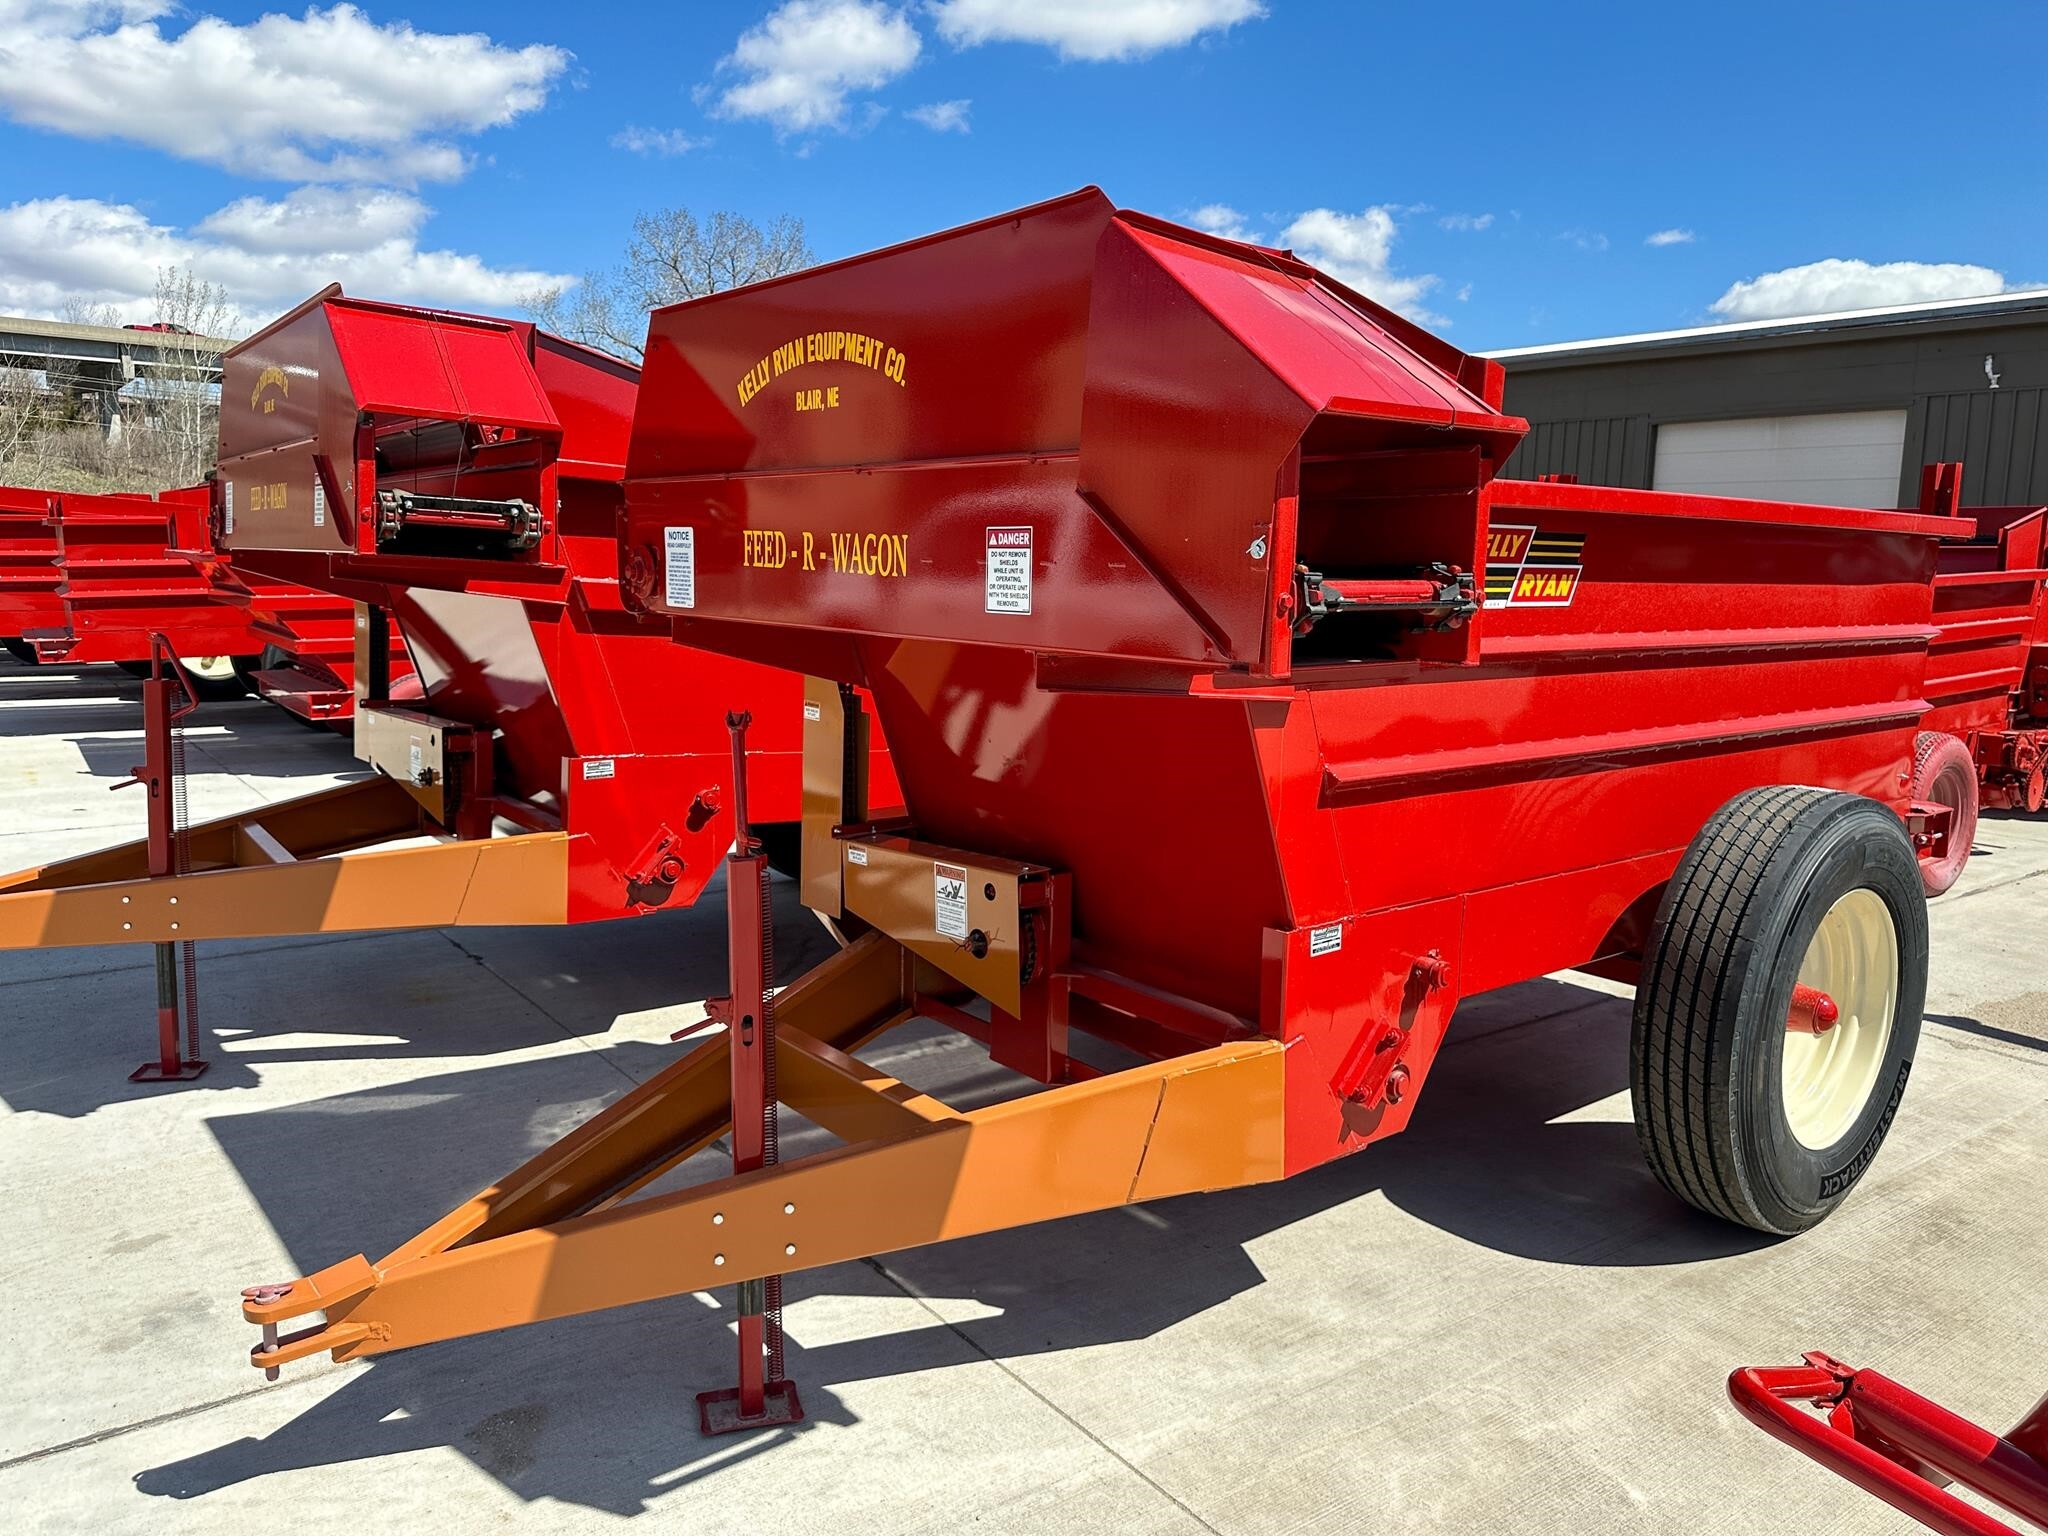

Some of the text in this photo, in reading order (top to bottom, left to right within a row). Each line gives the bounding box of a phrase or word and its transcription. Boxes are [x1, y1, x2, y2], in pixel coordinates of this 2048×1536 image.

[736, 331, 906, 407] KELLY RYAN EQUIPMENT CO.
[796, 386, 839, 411] BLAIR, NE
[668, 531, 689, 541] NOTICE
[998, 533, 1029, 545] DANGER
[743, 530, 787, 569] FEED
[802, 531, 816, 571] R
[831, 532, 908, 577] WAGON
[1517, 573, 1574, 597] RYAN
[1822, 1066, 1908, 1196] MASTERTRACK
